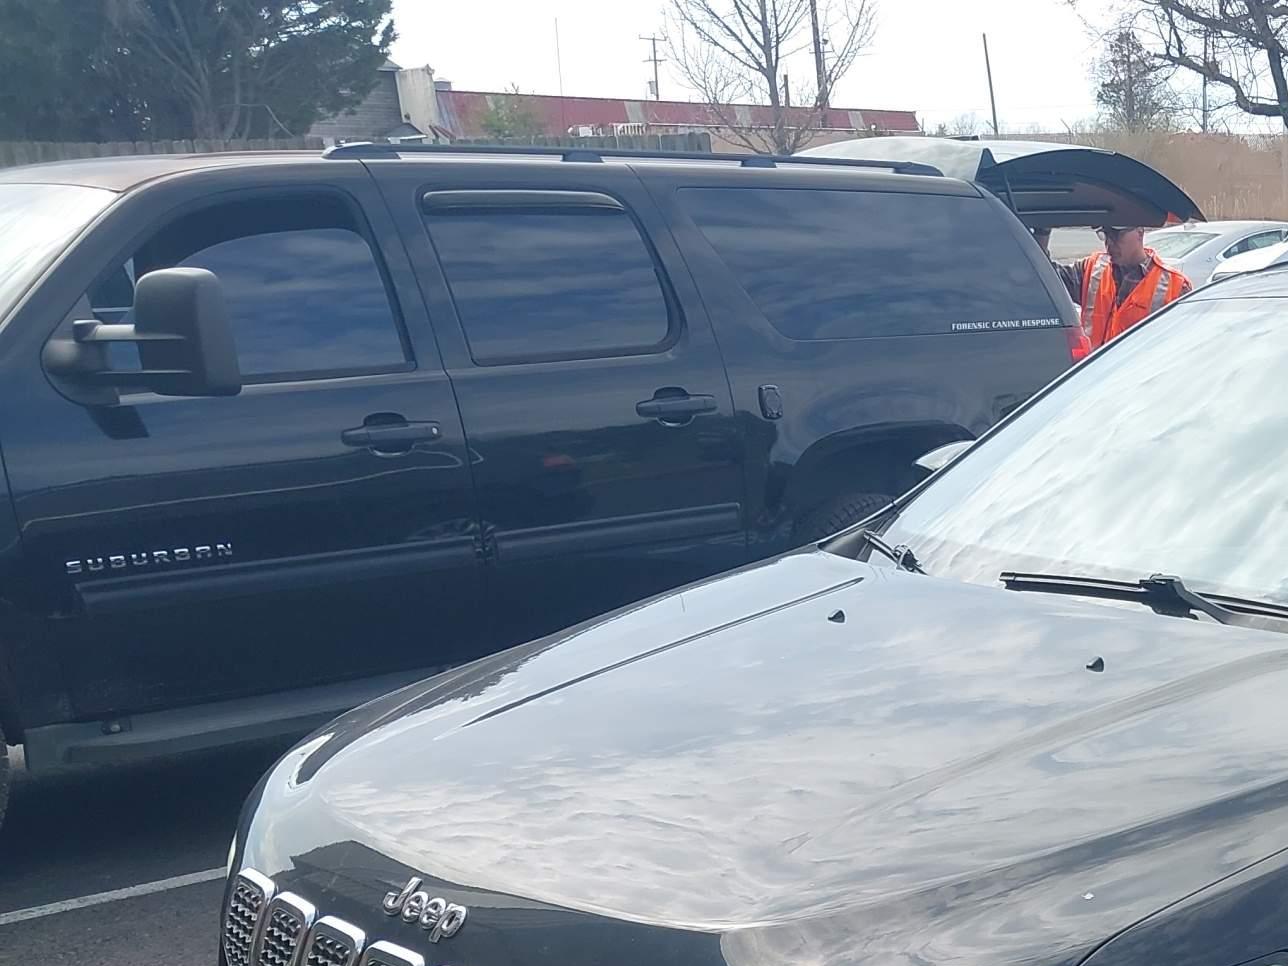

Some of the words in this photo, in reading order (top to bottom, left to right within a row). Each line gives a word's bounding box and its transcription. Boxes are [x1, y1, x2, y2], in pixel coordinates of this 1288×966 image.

[951, 321, 990, 331] FORENSIC
[991, 319, 1020, 329] CANINE
[1021, 318, 1060, 328] RESPONSE
[65, 543, 233, 574] SUBURBAN
[383, 876, 468, 943] Jeep
